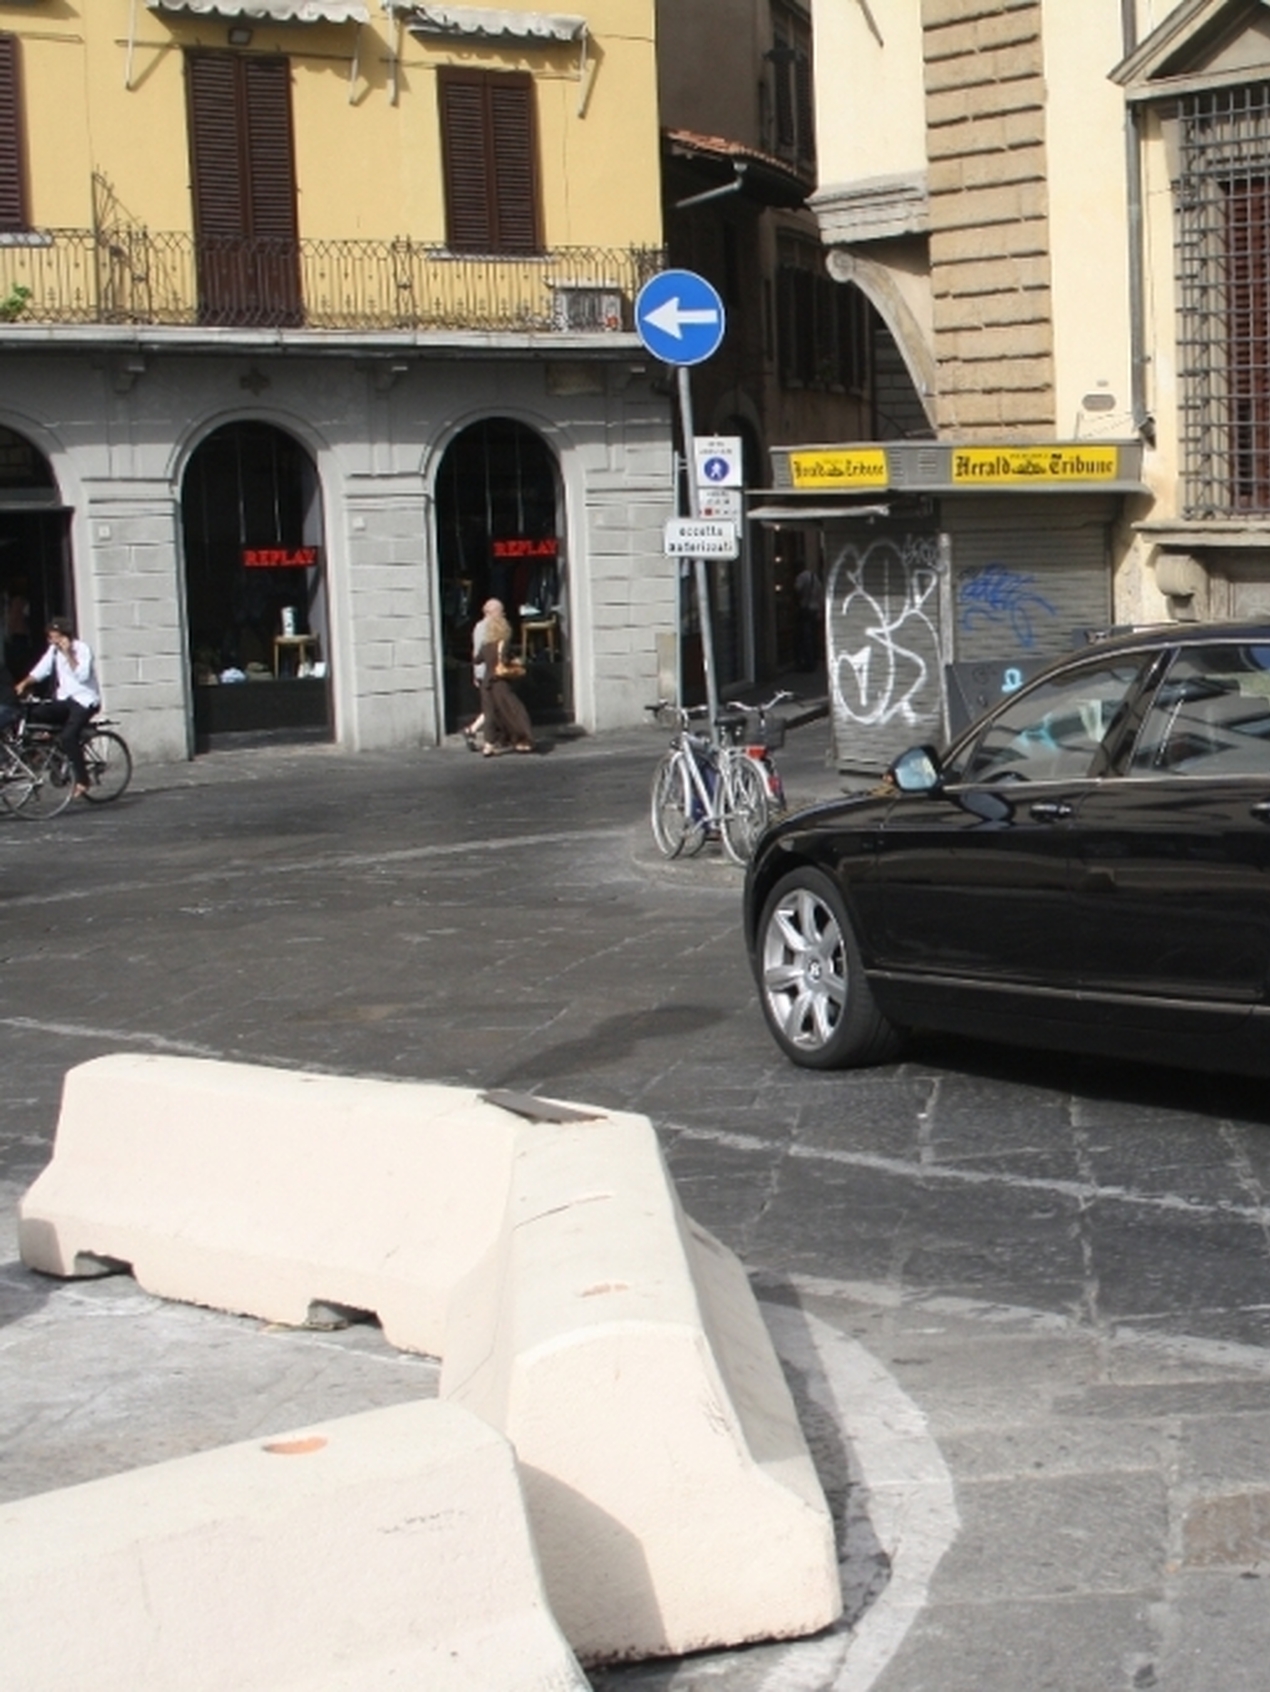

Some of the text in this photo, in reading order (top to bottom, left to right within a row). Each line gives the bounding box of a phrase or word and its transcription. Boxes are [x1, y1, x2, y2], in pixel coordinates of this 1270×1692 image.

[955, 454, 1114, 477] Herald Tribune
[244, 548, 315, 567] REPLAY
[494, 539, 557, 557] REPLAY
